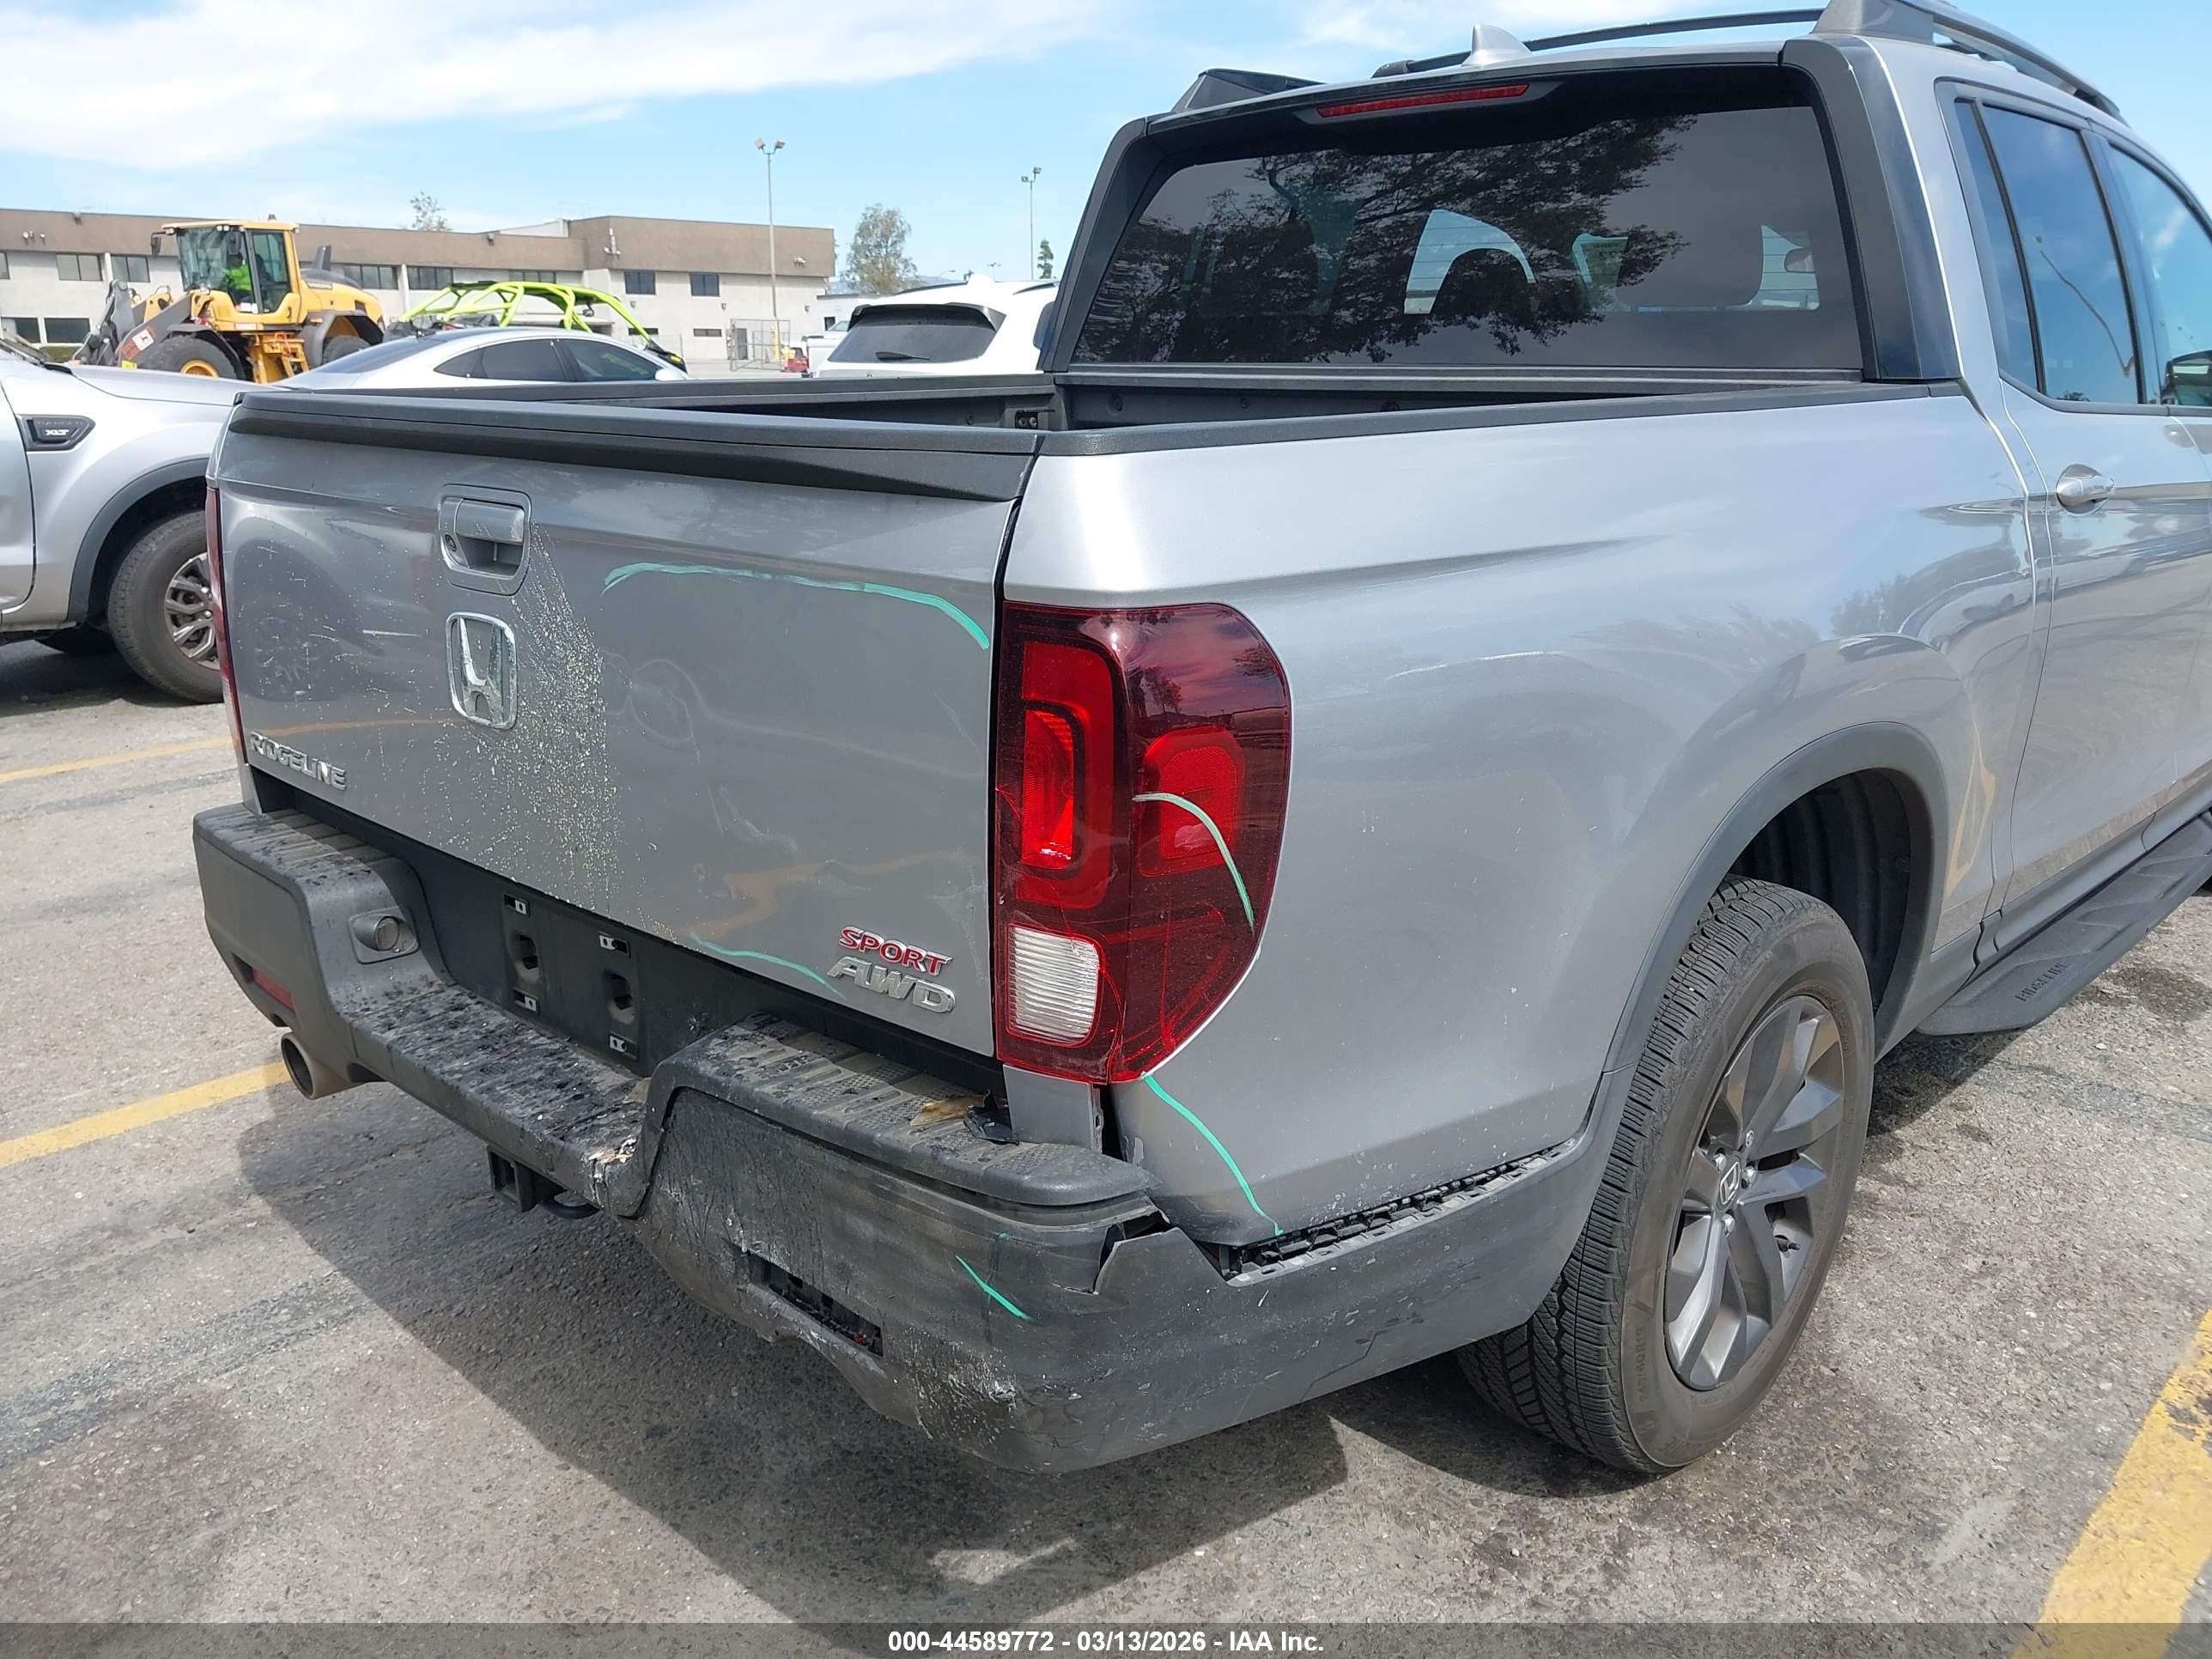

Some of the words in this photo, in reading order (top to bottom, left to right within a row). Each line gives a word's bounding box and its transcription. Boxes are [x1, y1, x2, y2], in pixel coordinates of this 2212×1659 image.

[250, 731, 346, 791] RIDGELINE
[838, 926, 954, 976] SPORT
[826, 956, 956, 1013] AWD
